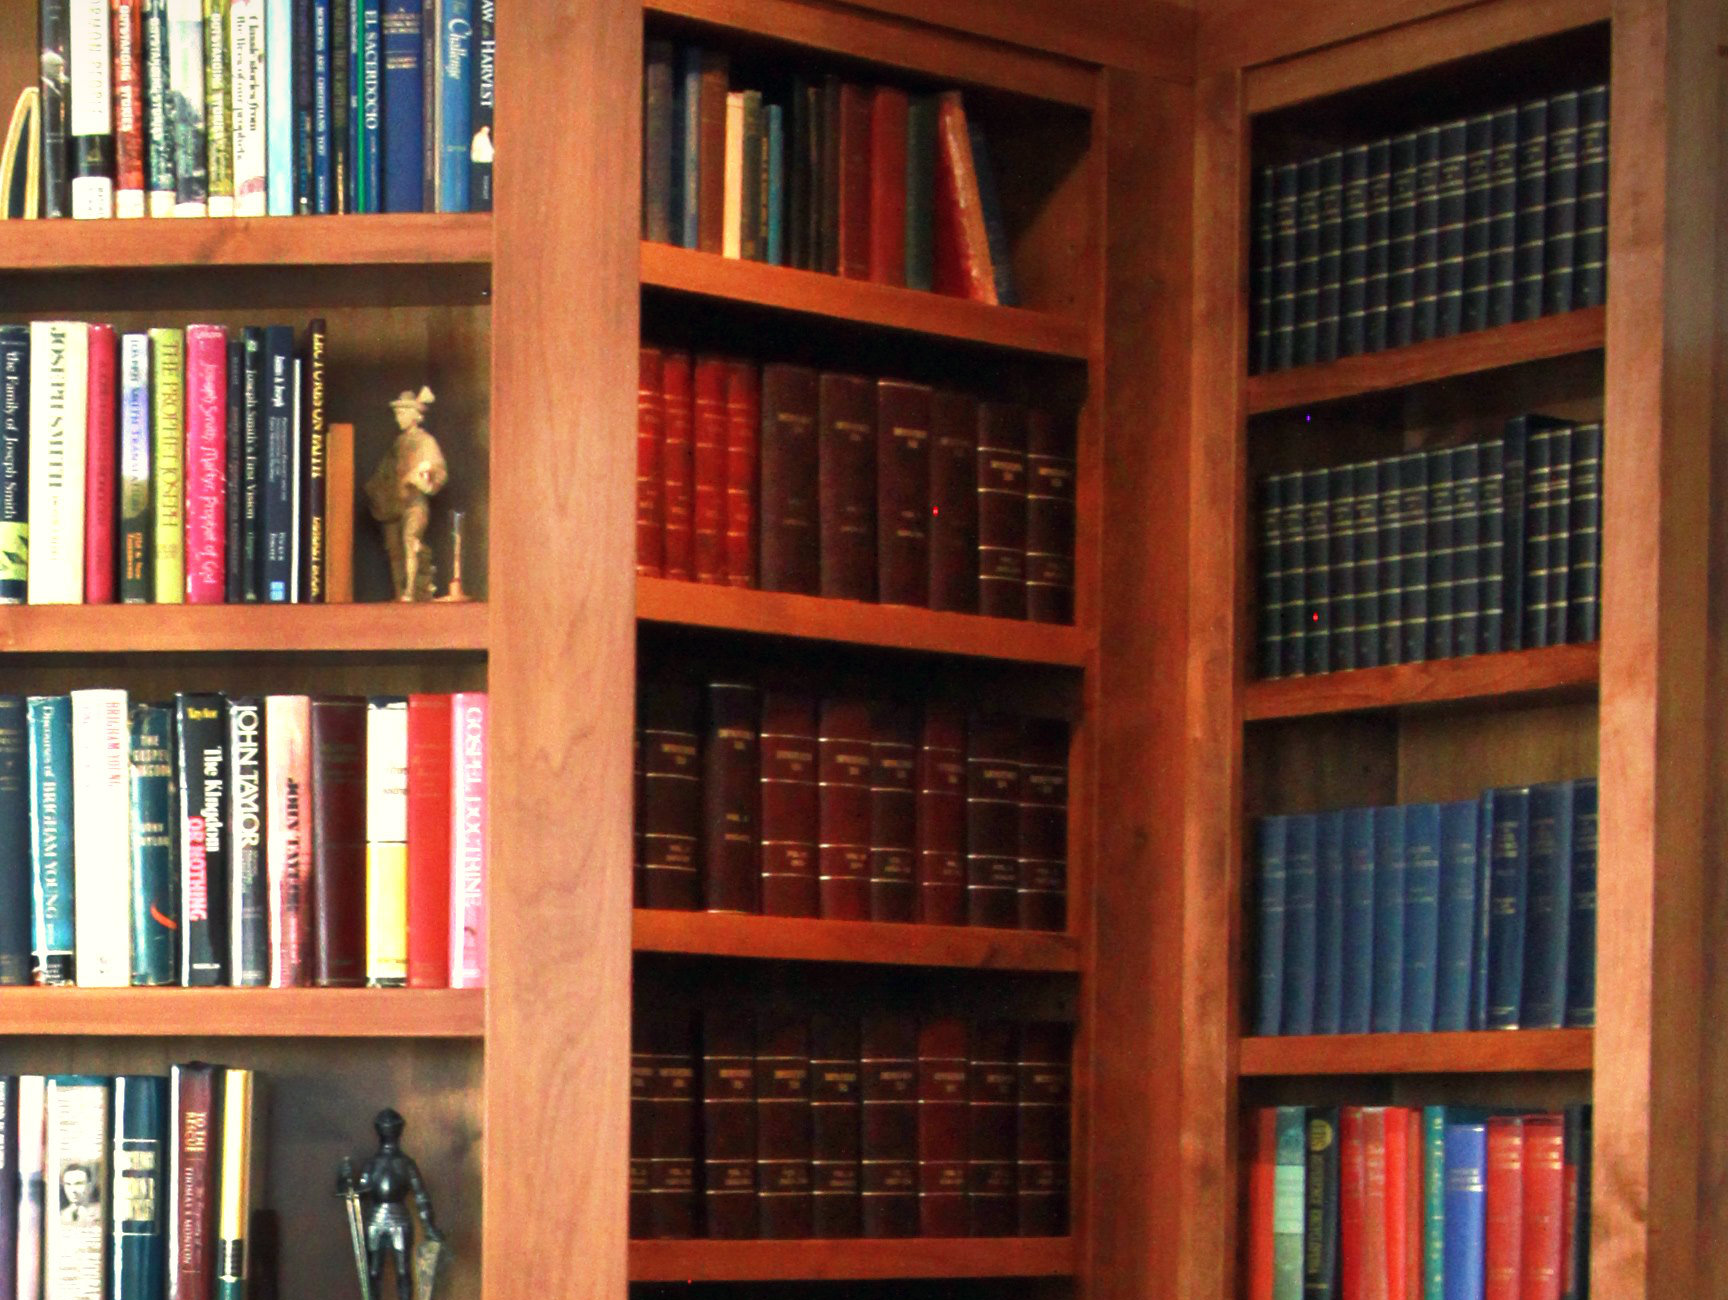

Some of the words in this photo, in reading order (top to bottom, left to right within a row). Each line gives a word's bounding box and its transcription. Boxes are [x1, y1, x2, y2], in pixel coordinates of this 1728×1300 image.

[364, 10, 379, 28] EL
[481, 0, 494, 23] AW
[444, 19, 473, 80] Challenge
[480, 41, 496, 109] HARVEST
[364, 32, 379, 130] SACERDOCIO
[3, 352, 20, 374] The
[48, 328, 67, 411] JOSEPH
[159, 340, 179, 377] THE
[0, 376, 20, 414] Family
[246, 369, 257, 408] Joseph
[3, 418, 20, 432] of
[159, 380, 179, 461] PROPHET
[246, 411, 257, 453] Smith's
[0, 433, 20, 478] Joseph
[48, 416, 67, 489] SMITH
[3, 479, 20, 520] Smith
[159, 465, 179, 528] JOSEPH
[246, 484, 257, 519] Vision
[203, 746, 223, 777] The
[236, 705, 259, 766] JOHN
[464, 706, 482, 790] GOSPEL
[43, 780, 57, 858] BRIGHAM
[189, 816, 207, 836] OR
[199, 779, 223, 853] Kingdom
[236, 769, 259, 848] TAYLOR
[464, 796, 482, 908] DOCTRINE
[45, 860, 59, 919] YOUNG
[189, 837, 207, 922] NOTHING
[195, 1112, 207, 1126] TO
[195, 1129, 207, 1152] THE
